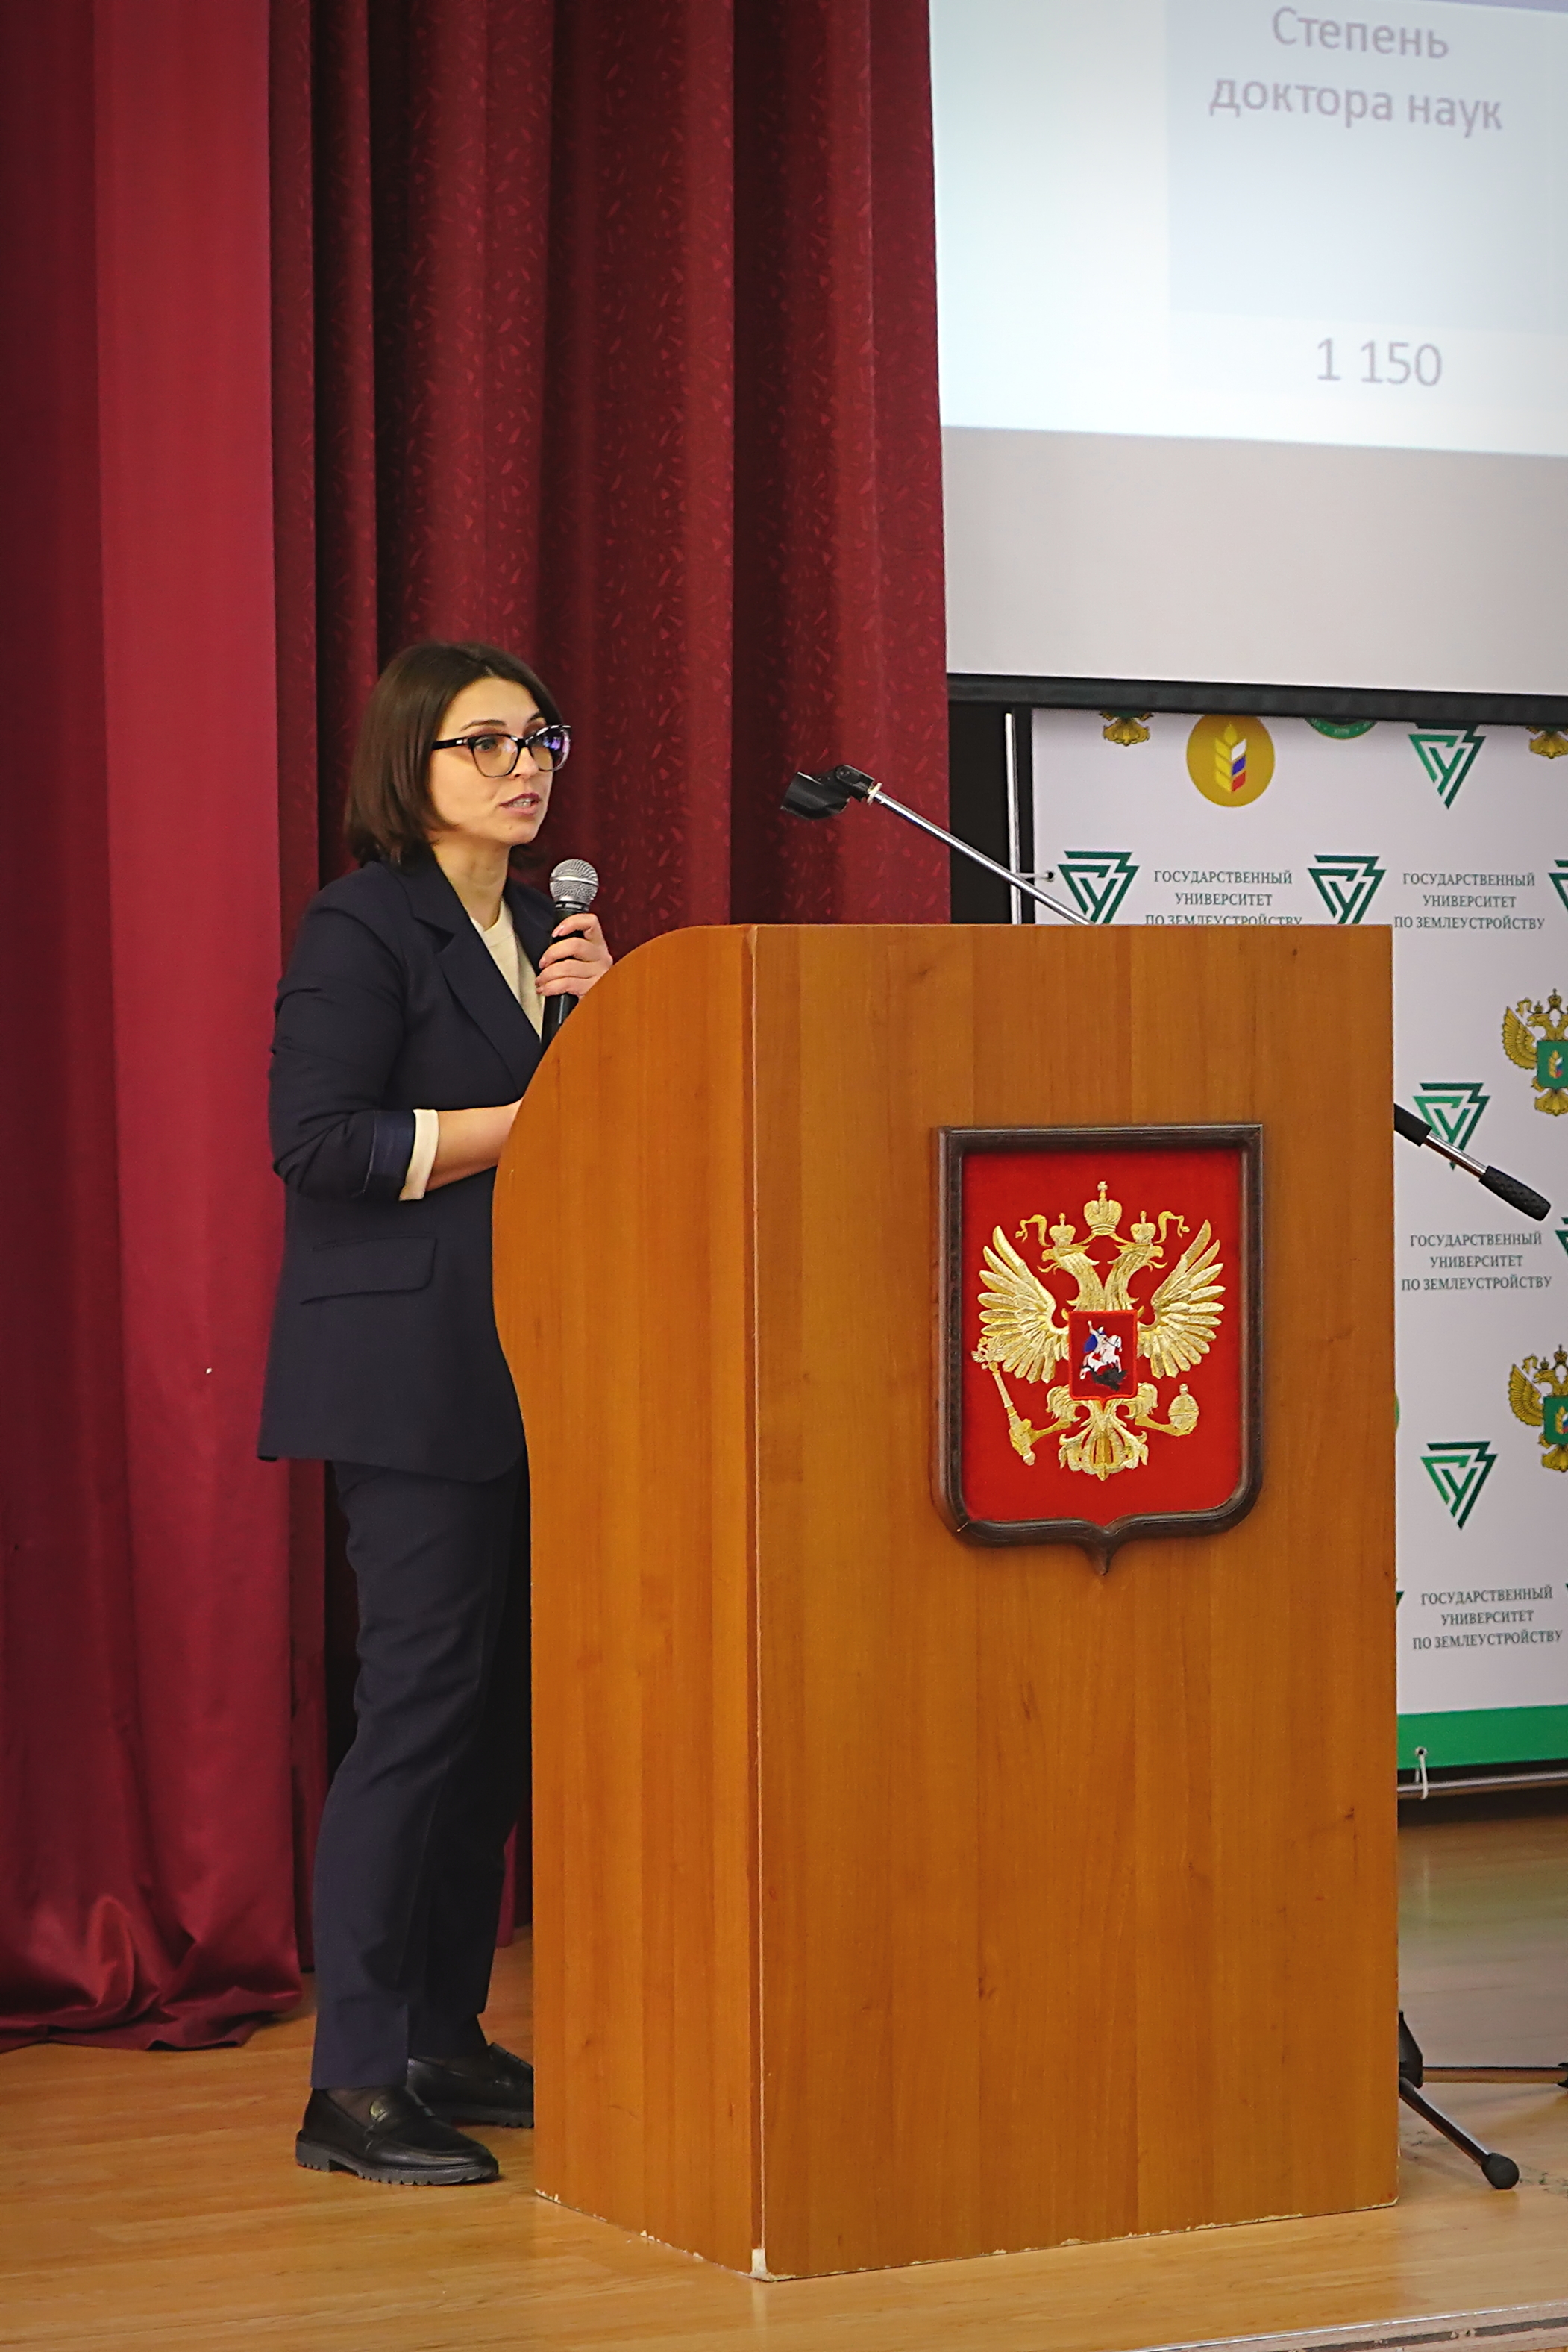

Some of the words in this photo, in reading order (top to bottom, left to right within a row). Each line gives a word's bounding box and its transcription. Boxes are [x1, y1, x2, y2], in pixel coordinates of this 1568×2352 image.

[1272, 7, 1449, 59] Степень
[1209, 78, 1393, 129] доктора
[1408, 94, 1503, 139] наук
[1153, 870, 1293, 885] ГОСУДАРСТВЕННЫЙ
[1402, 871, 1535, 887] ГОСУДАРСТВЕННЫЙ
[1174, 892, 1273, 906] УНИВЕРСИТЕТ
[1422, 894, 1517, 909] УНИВЕРСИТЕТ
[1394, 916, 1414, 929] ПО
[1416, 915, 1546, 930] ЗЕМЛЕУСТРОЙСТВУ
[1410, 1230, 1543, 1248] ГОСУДАРСТВЕННЫЙ
[1430, 1255, 1523, 1268] УНИВЕРСИТЕТ
[1402, 1278, 1420, 1291] ПО
[1423, 1273, 1552, 1291] ЗЕМЛЕУСТРОЙСТВУ
[1421, 1584, 1553, 1605] ГОСУДАРСТВЕННЫЙ
[1440, 1609, 1534, 1626] УНИВЕРСИТЕТ
[1412, 1637, 1432, 1650] ПО
[1434, 1628, 1563, 1649] ЗЕМЛЕУСТРОЙСТВУ
